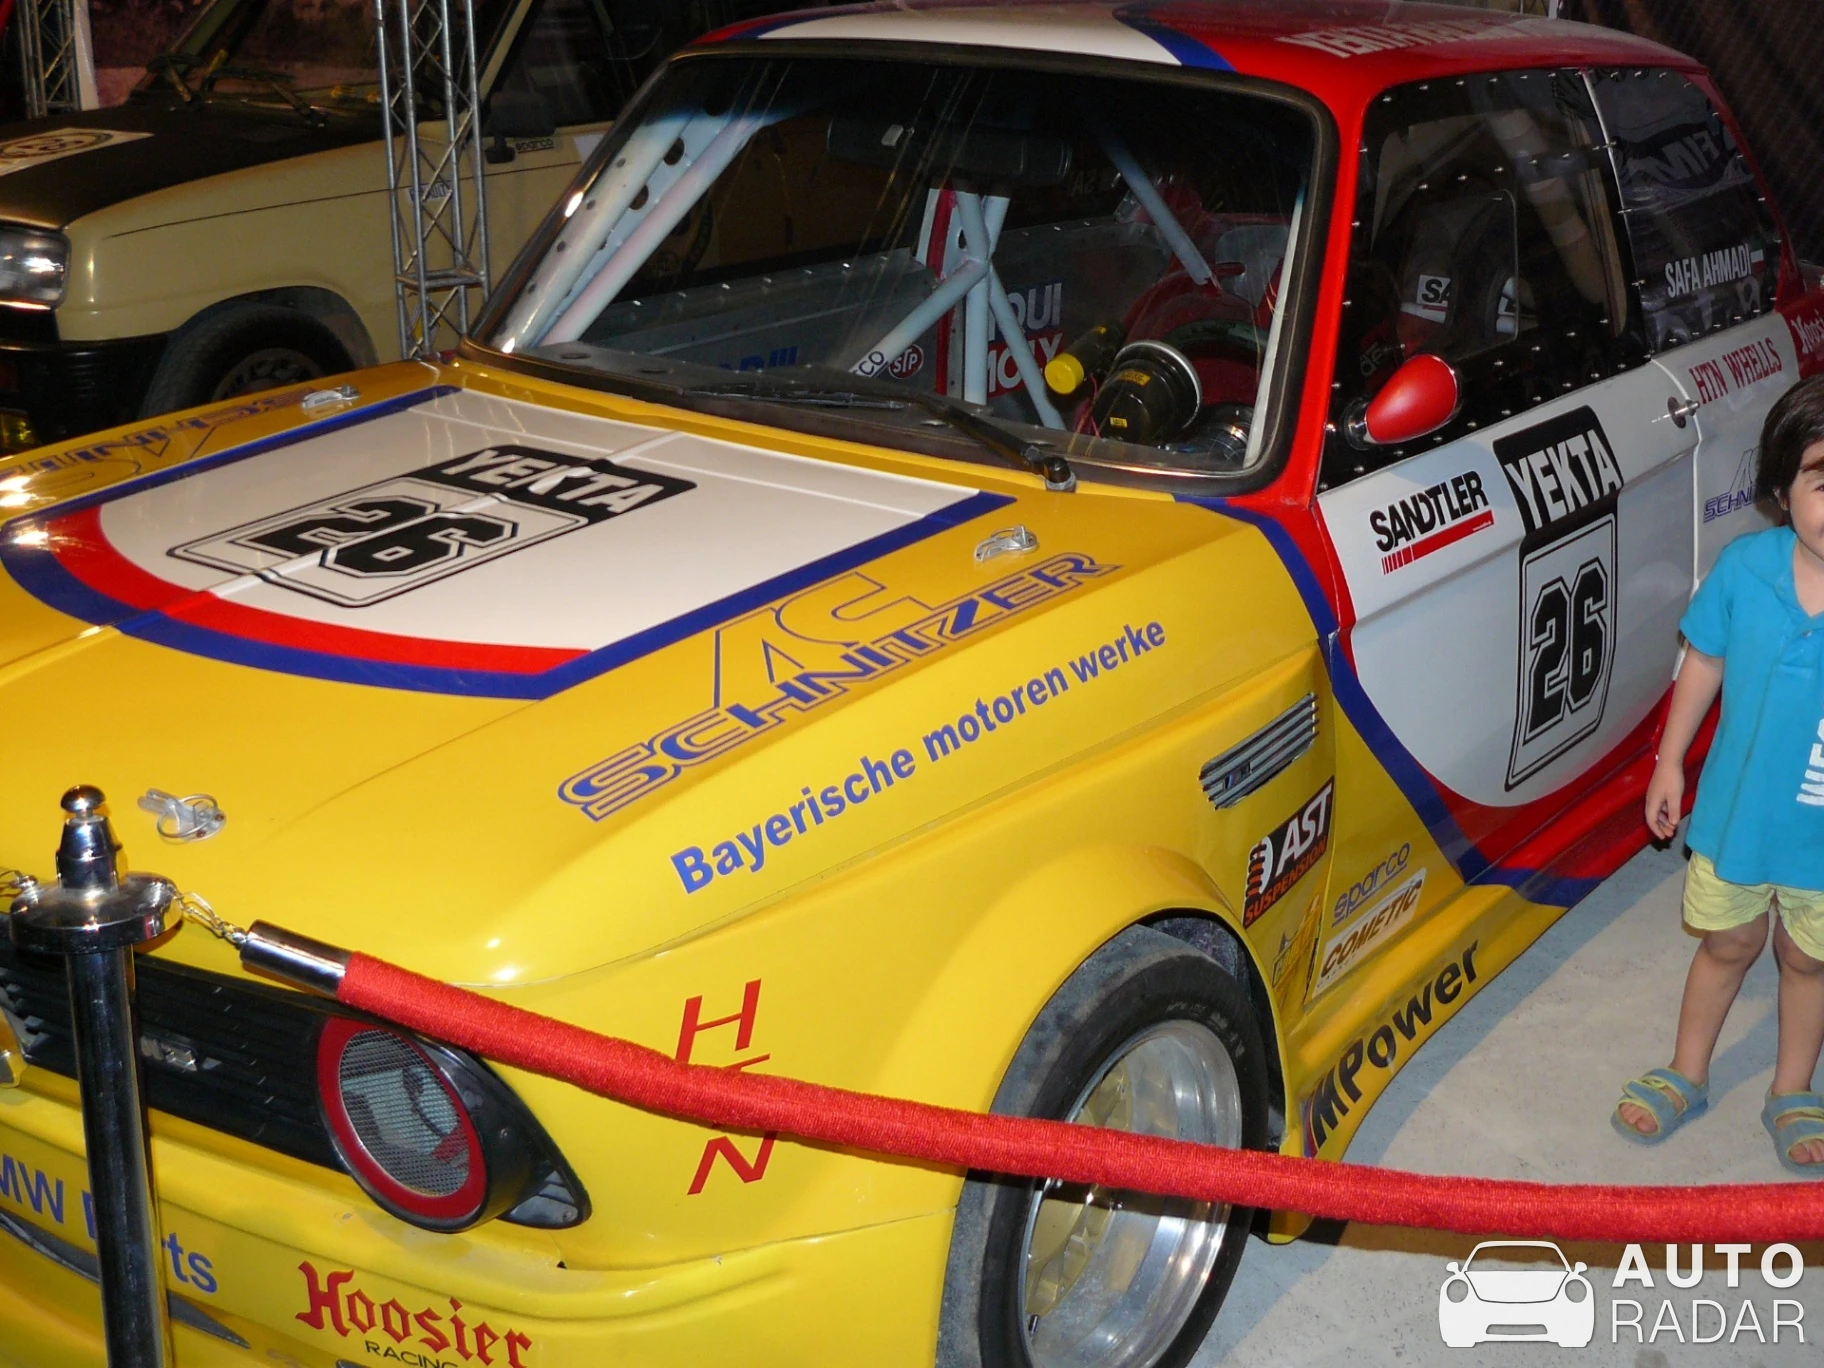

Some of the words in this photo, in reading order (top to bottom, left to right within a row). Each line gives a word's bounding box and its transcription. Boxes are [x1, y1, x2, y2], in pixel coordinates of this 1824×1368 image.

[1665, 257, 1701, 298] SAFA
[1702, 243, 1752, 287] AHMADI
[893, 347, 917, 374] STP
[1688, 359, 1728, 405] HTN
[440, 449, 666, 514] YEKTA
[1369, 470, 1489, 552] SANDTLER
[1504, 429, 1623, 530] YEKTA
[230, 495, 519, 579] 26
[1523, 556, 1608, 747] 26
[671, 742, 916, 895] Bayerische
[922, 666, 1069, 764] motoren
[1069, 618, 1166, 684] werke
[1275, 781, 1333, 878] AST
[1245, 835, 1329, 922] SUSPENSION
[1332, 842, 1411, 925] sparco
[1320, 879, 1423, 979] COMETIC
[295, 1260, 533, 1368] Hoosier
[365, 1340, 459, 1368] RACIN
